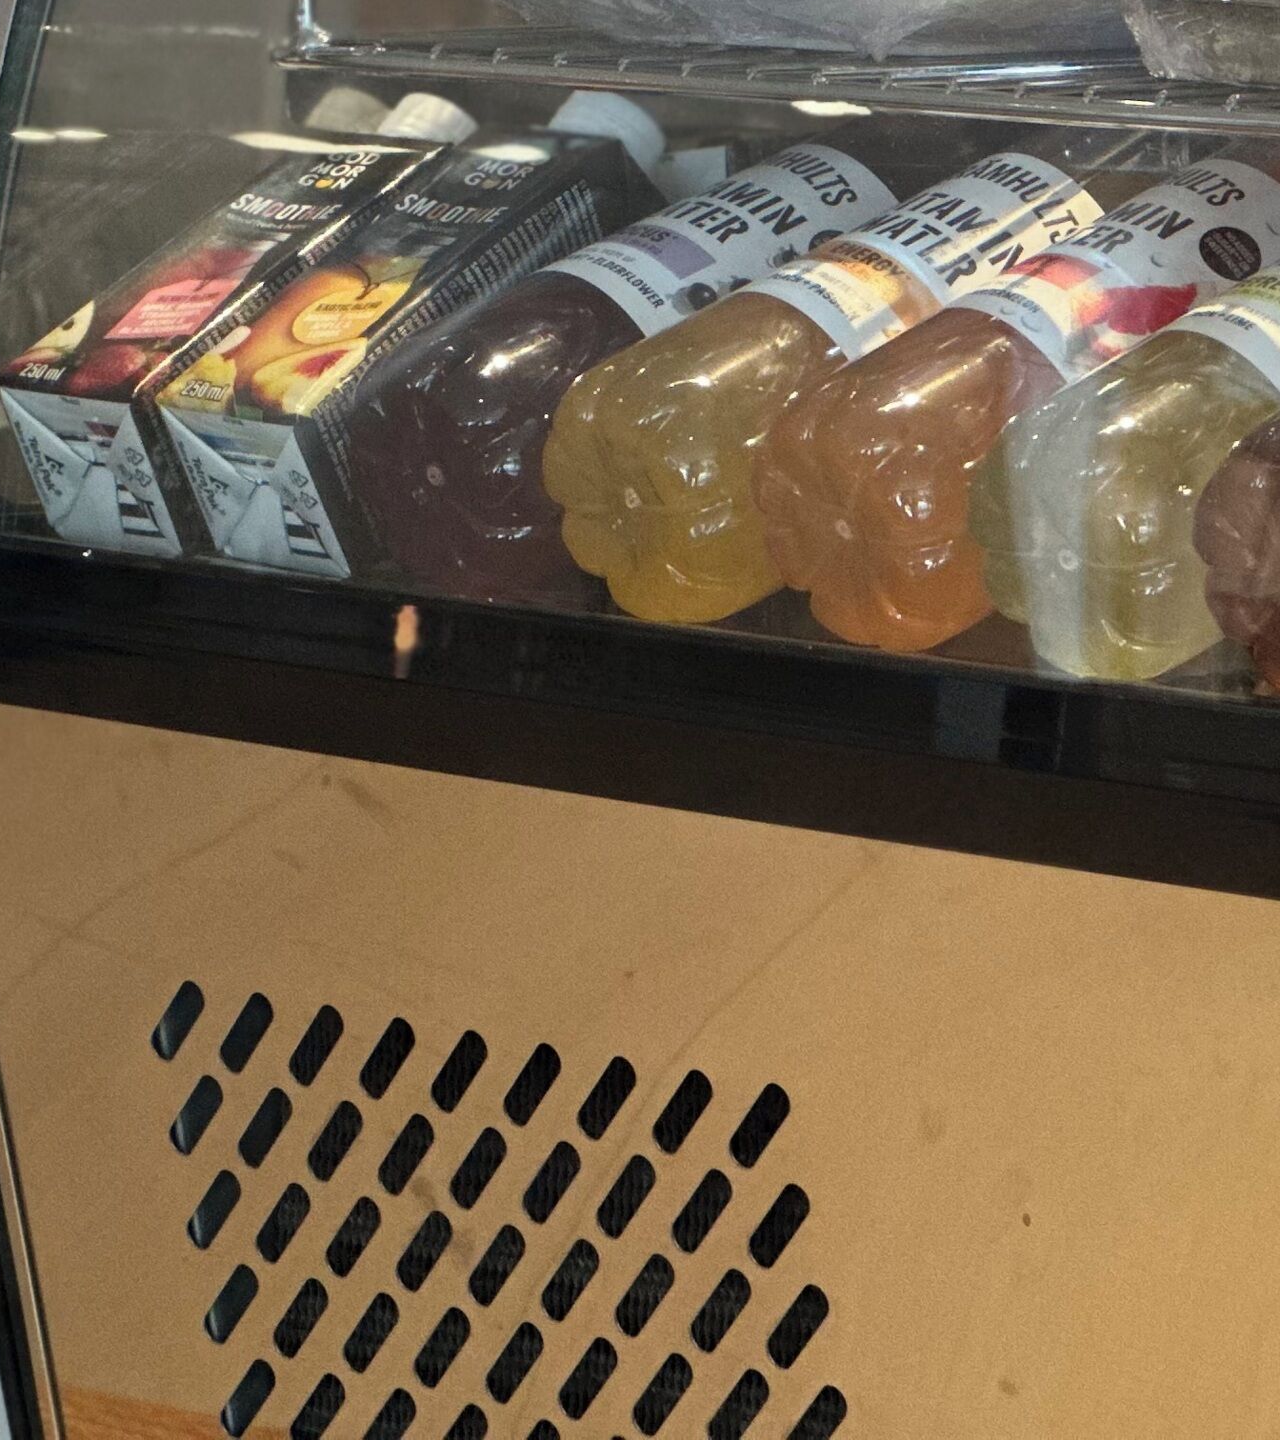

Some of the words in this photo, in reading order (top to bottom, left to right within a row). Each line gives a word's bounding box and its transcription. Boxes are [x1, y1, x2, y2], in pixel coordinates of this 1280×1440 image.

[310, 162, 367, 178] MOR
[477, 160, 534, 178] MOR
[230, 193, 343, 221] SMOOTHIE
[394, 194, 509, 224] SMOOTHIE
[19, 362, 45, 379] 250
[44, 366, 67, 381] ml
[181, 380, 209, 397] 250
[208, 384, 227, 401] ml
